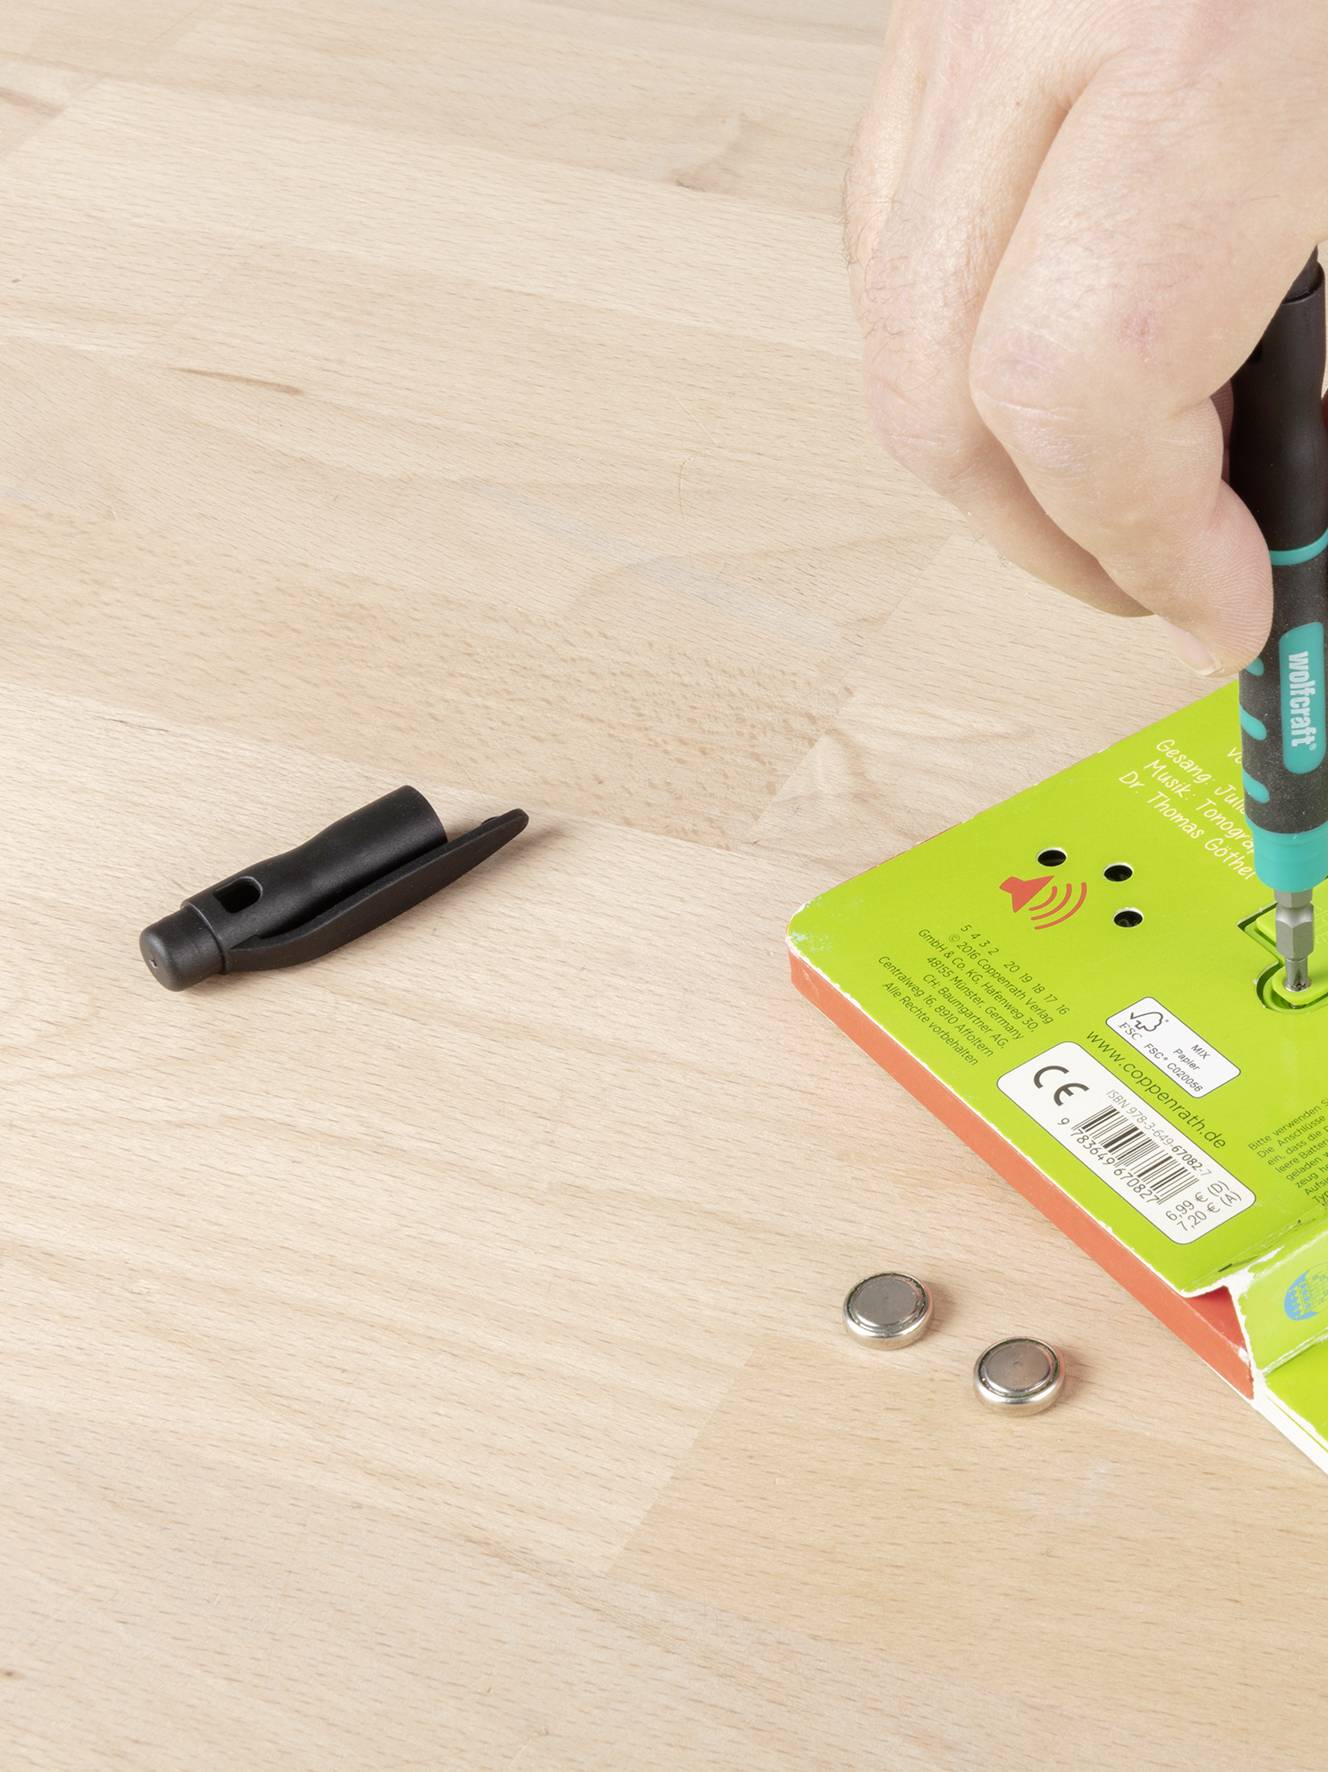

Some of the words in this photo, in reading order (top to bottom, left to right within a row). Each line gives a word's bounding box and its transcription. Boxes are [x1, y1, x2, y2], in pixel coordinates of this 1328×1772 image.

[1156, 739, 1215, 785] Gesang:
[1119, 770, 1145, 794] Dr.
[1147, 791, 1204, 839] Thomas
[1204, 837, 1256, 880] Göthel
[1144, 759, 1197, 801] Musik:
[1195, 798, 1254, 854] Tonogra
[878, 956, 925, 997] Centralweg
[933, 1004, 960, 1026] 8910
[917, 927, 947, 953] GmbH
[944, 949, 956, 960] &
[981, 982, 1024, 1020] Hafenweg
[924, 956, 954, 979] 48155
[985, 1006, 1024, 1040] Germany
[938, 987, 993, 1033] Baumgartner
[956, 940, 981, 960] 2016
[977, 959, 1026, 1000] Coppenrath
[1025, 997, 1054, 1024] Verlag
[960, 924, 972, 933] 5
[970, 932, 981, 941] 4
[979, 940, 990, 948] 3
[1003, 959, 1022, 974] 20
[1017, 973, 1034, 985] 19
[1031, 983, 1046, 995] 18
[1043, 993, 1058, 1005] 17
[1055, 1004, 1071, 1016] 16
[884, 981, 902, 998] Alle
[899, 996, 931, 1023] Rechte
[927, 1022, 978, 1065] vorbehalten
[1119, 1022, 1142, 1039] FSC
[1173, 1048, 1200, 1070] Papier
[1191, 1045, 1210, 1060] MIX
[1086, 1031, 1226, 1148] www.coppenrath.de
[1105, 1089, 1130, 1109] ISBN
[1130, 1108, 1211, 1173] 978-3-649-67082-7
[1055, 1116, 1070, 1127] 9
[1071, 1129, 1115, 1165] 783649
[1113, 1168, 1160, 1202] 670827
[1165, 1200, 1195, 1221] 6,99
[1195, 1192, 1208, 1202] €
[1207, 1181, 1229, 1197] (D)
[1177, 1211, 1207, 1231] 7,20
[1207, 1202, 1220, 1213] €
[1220, 1191, 1242, 1207] (A)
